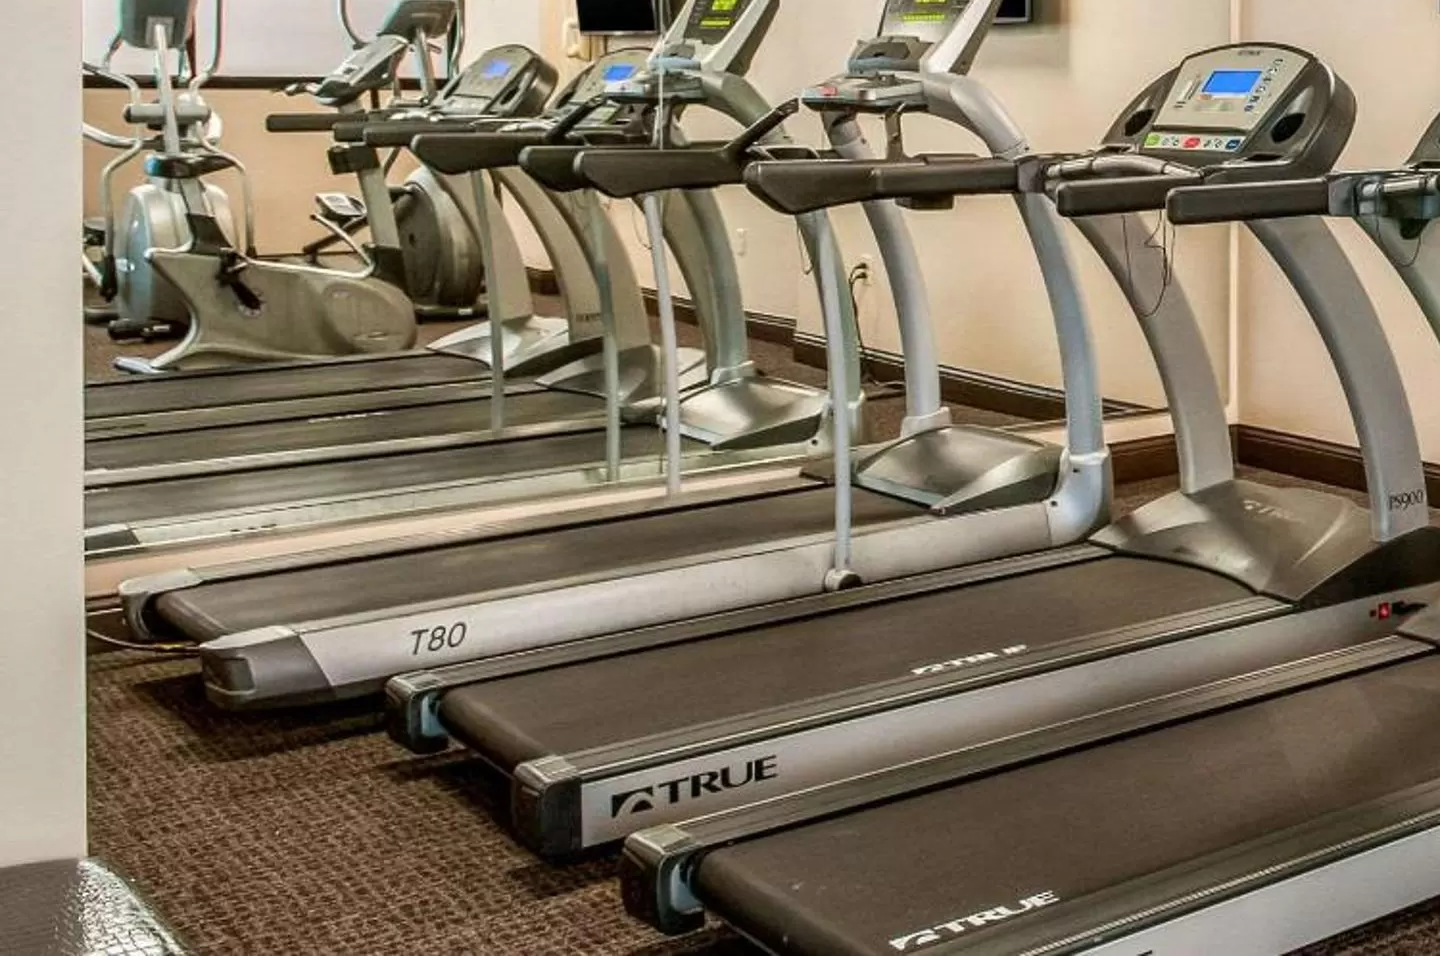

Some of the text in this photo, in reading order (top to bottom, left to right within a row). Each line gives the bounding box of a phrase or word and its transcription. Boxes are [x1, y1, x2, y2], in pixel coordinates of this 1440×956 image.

[411, 621, 467, 655] T80
[658, 755, 778, 804] TRUE
[935, 889, 1061, 933] TRUE
